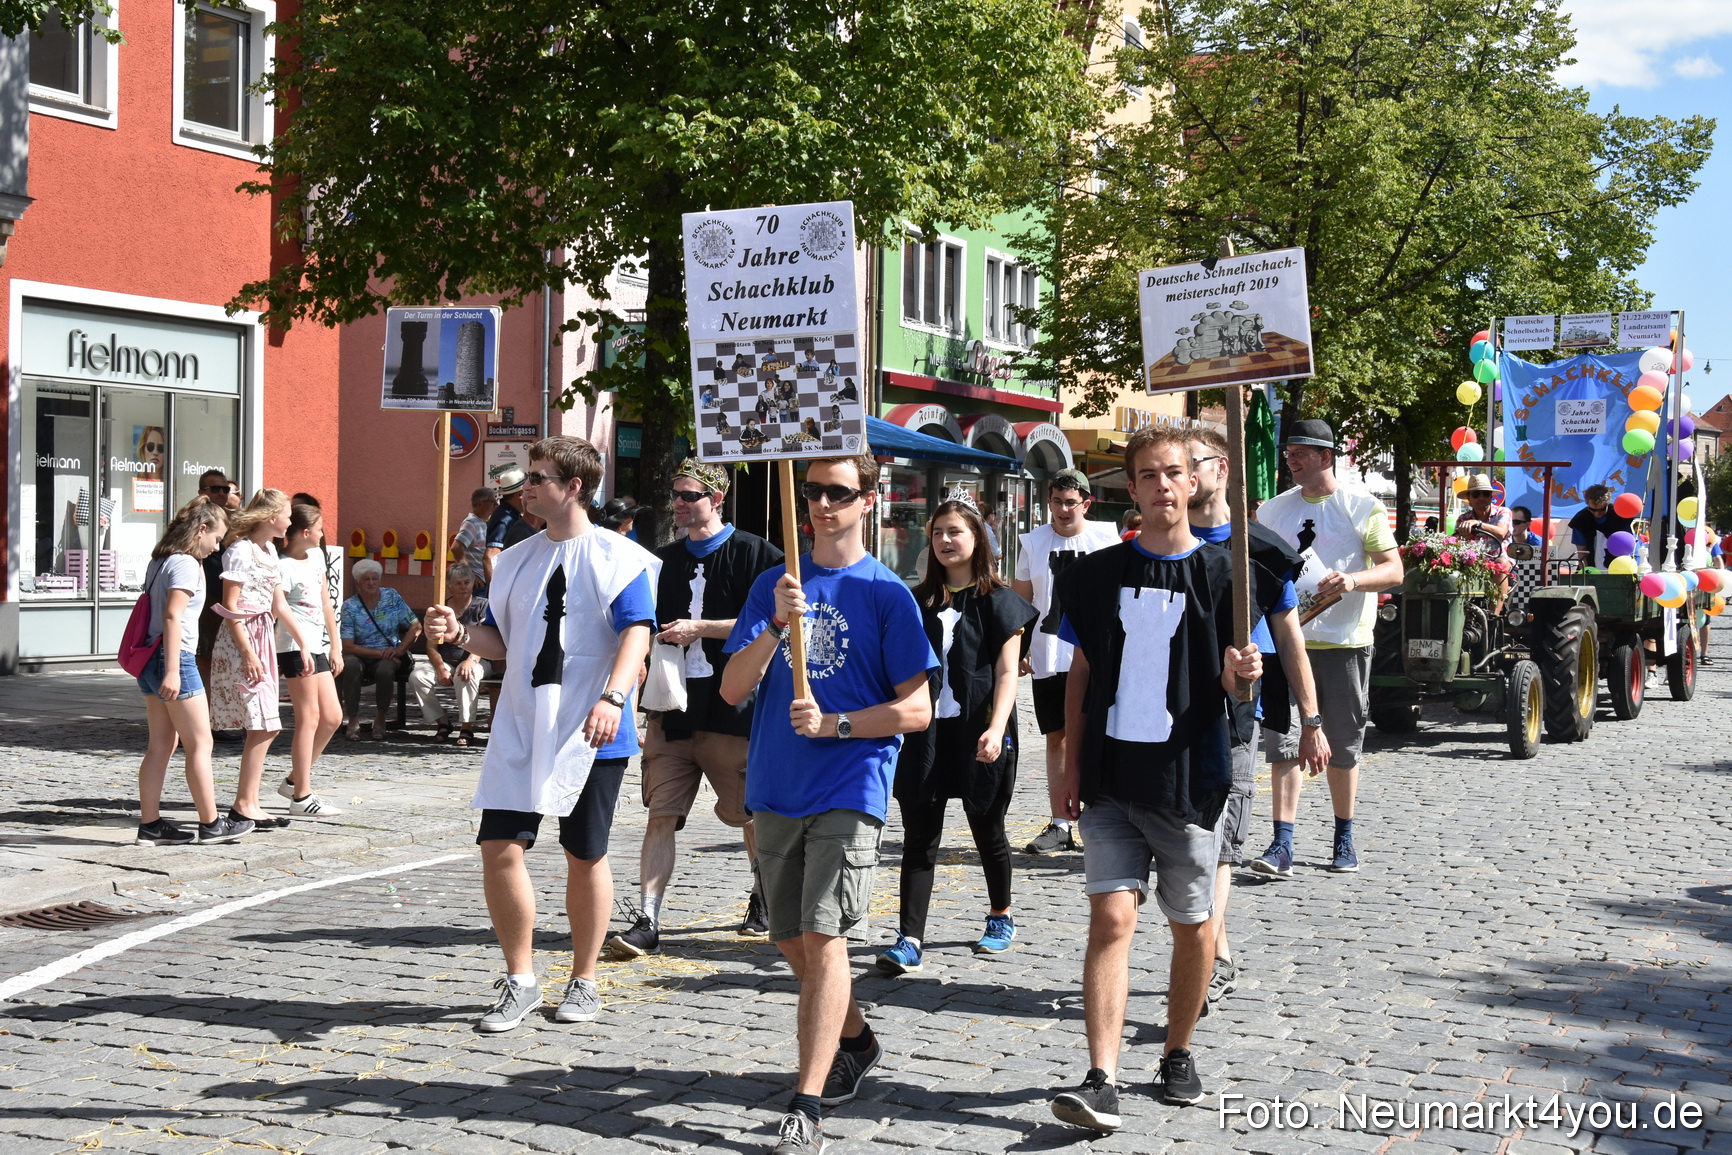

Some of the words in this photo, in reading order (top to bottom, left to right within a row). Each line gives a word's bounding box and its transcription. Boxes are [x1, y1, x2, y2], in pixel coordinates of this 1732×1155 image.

[691, 219, 734, 239] SCHACHKLUB
[755, 214, 780, 235] 70
[800, 211, 844, 231] SCHACHKLUB
[692, 250, 729, 269] NEUMARKT
[737, 246, 800, 268] Jahre
[800, 242, 838, 261] NEUMARKT
[1146, 270, 1200, 288] Deutsche
[1203, 256, 1298, 280] Schnellschach-
[707, 274, 835, 302] Schachklub
[1165, 281, 1246, 303] meisterschaft
[1249, 276, 1279, 292] 2019
[404, 311, 416, 319] Der
[417, 311, 433, 319] Turm
[434, 311, 441, 319] in
[442, 311, 453, 319] der
[454, 311, 483, 319] Schlacht
[719, 307, 828, 332] Neumarkt
[1622, 313, 1668, 321] 21./22.09.2019
[1506, 326, 1552, 334] Schnellschach-
[1628, 332, 1661, 340] Neumarkt
[1508, 336, 1550, 344] meisterschaft
[488, 425, 536, 436] Bockwirtsgasse
[110, 456, 156, 473] fielmann
[804, 602, 849, 632] ACHKLUB
[1410, 649, 1421, 657] DR
[1419, 640, 1433, 648] NM
[781, 646, 835, 679] NEUARKT
